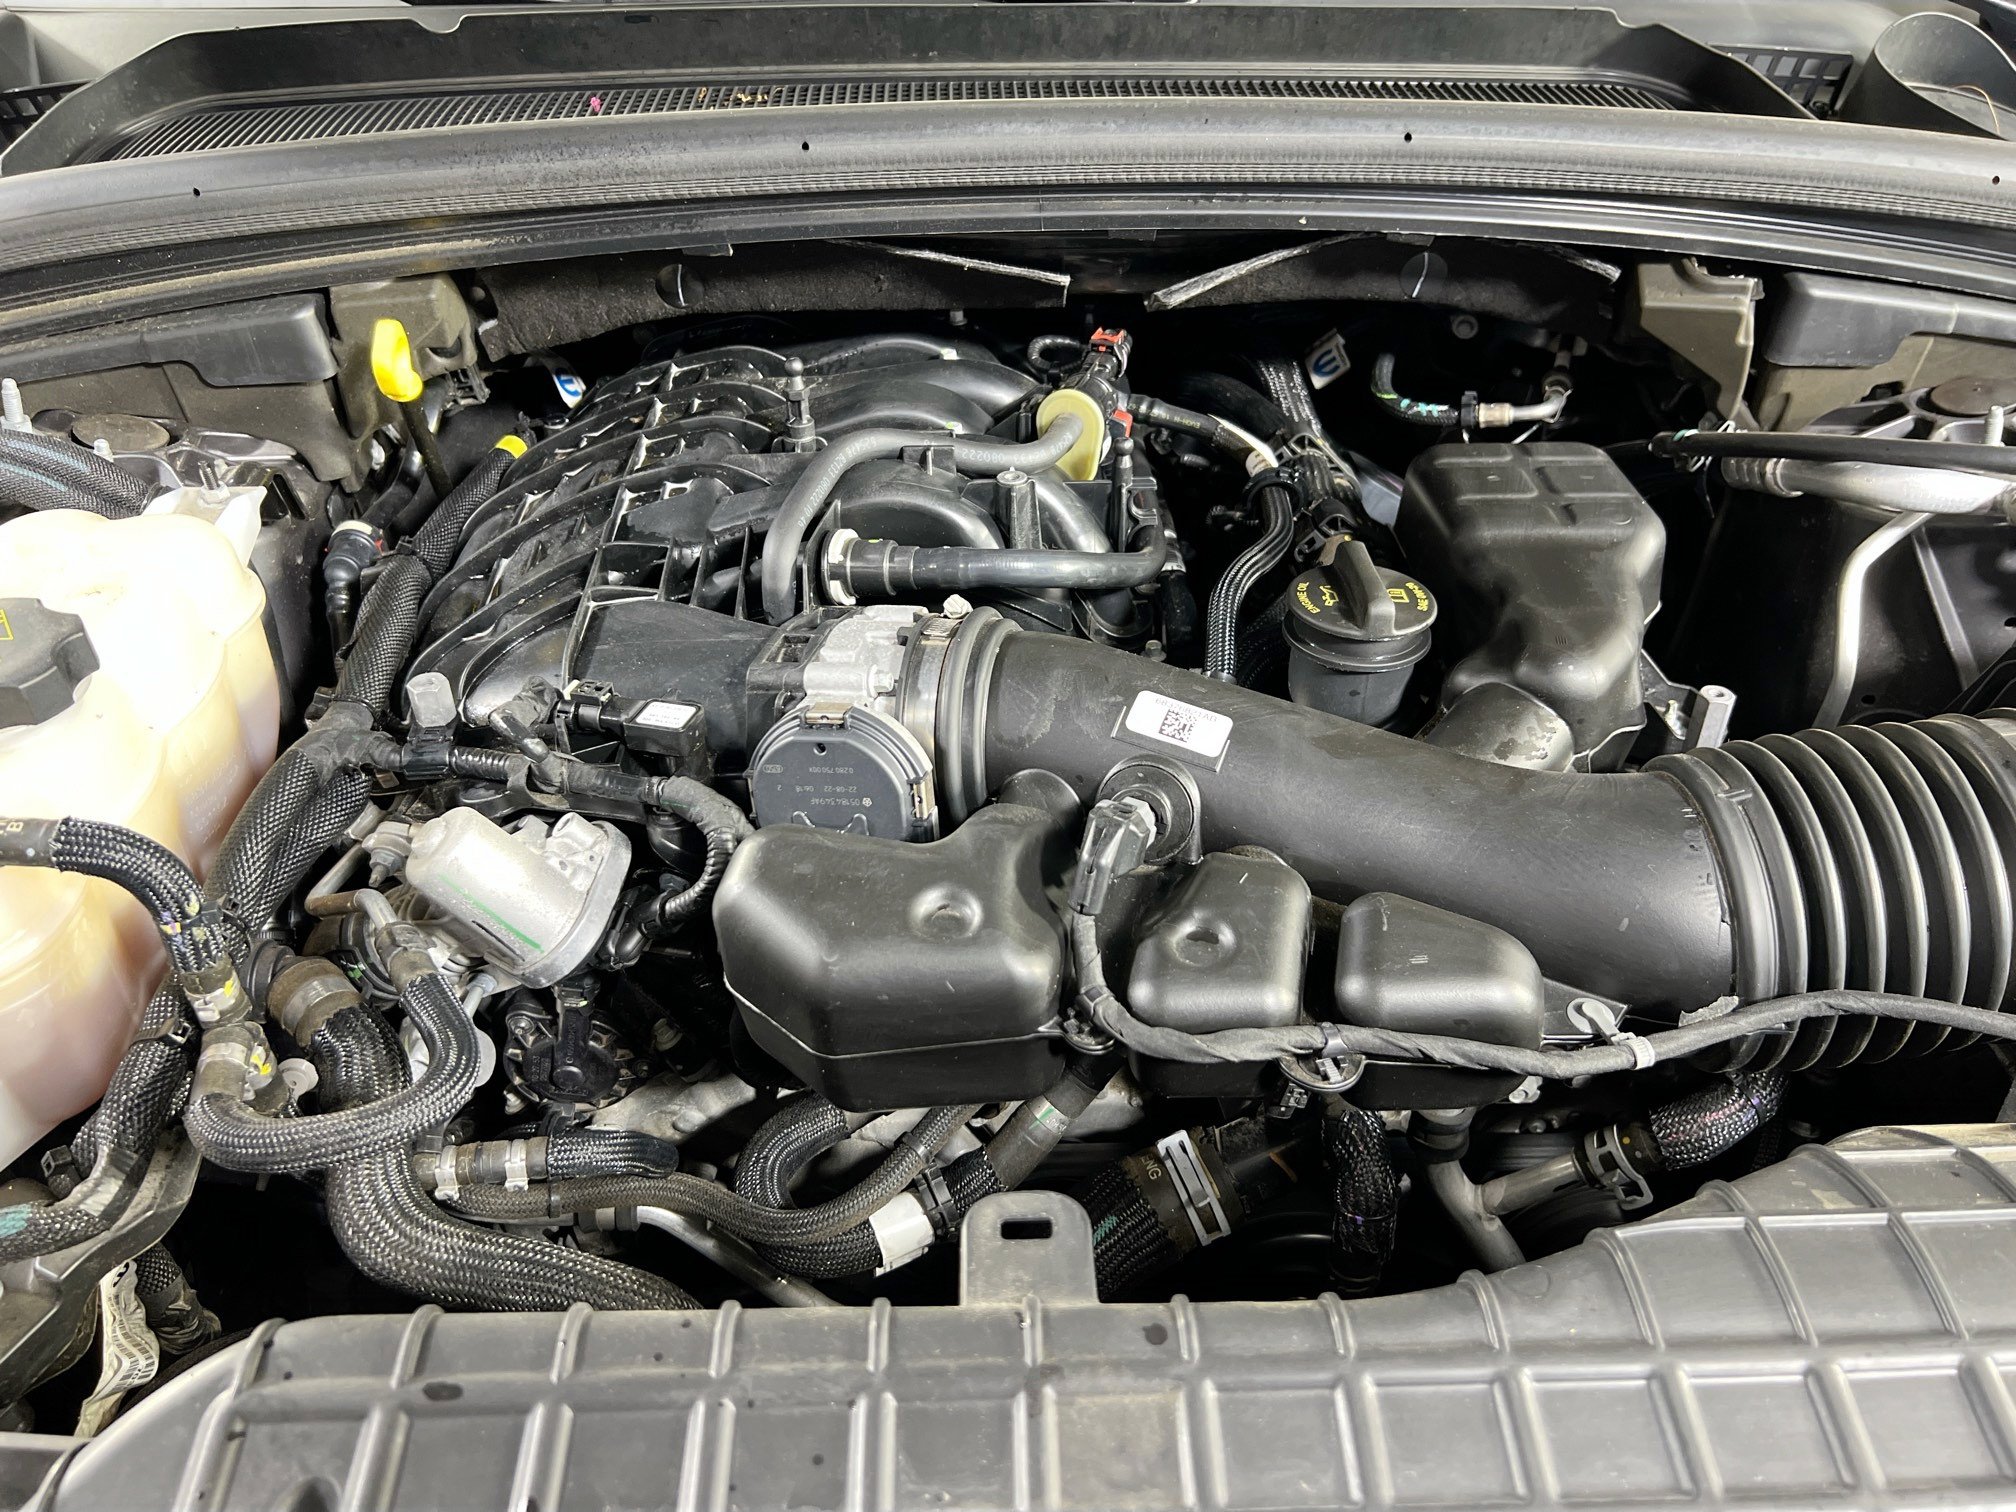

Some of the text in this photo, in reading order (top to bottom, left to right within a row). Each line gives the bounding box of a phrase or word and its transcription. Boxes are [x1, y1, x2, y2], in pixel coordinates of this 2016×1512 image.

[961, 448, 1005, 463] 080222
[810, 476, 831, 507] 080222
[1297, 582, 1320, 614] ENGINE OIL
[1417, 599, 1428, 612] SAE
[824, 785, 857, 793] 22-08-22
[1141, 1155, 1162, 1180] ENG
